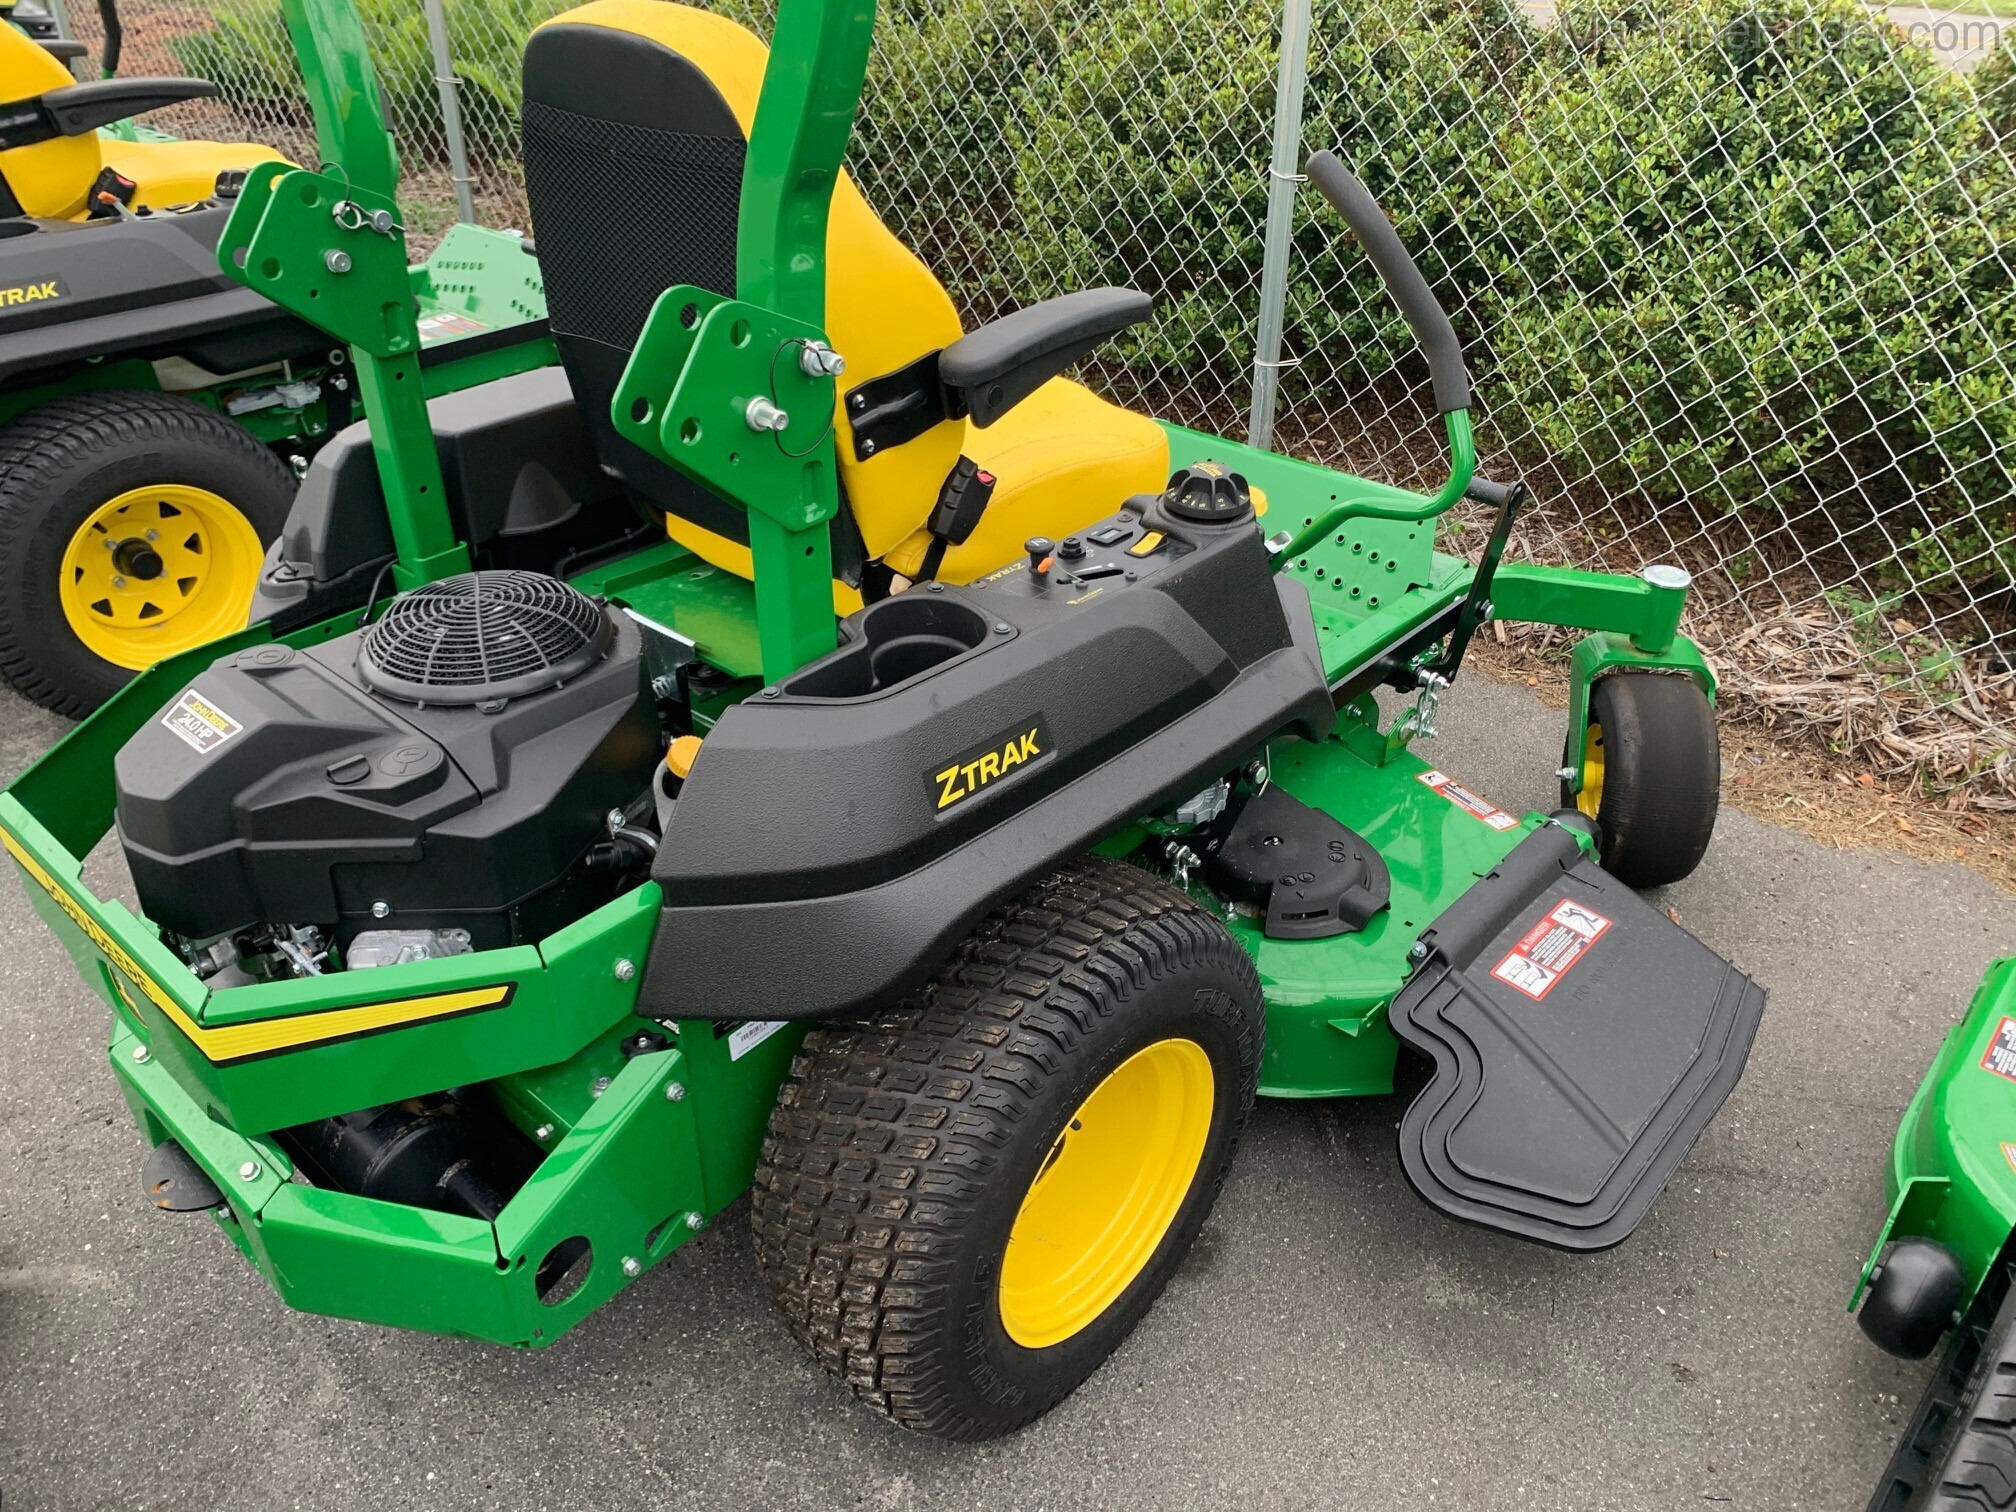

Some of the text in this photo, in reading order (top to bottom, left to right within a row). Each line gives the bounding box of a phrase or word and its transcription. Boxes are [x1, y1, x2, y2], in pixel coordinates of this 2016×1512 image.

[194, 725, 214, 739] HP
[206, 711, 229, 731] DEERE
[935, 727, 1041, 809] ZTRAK
[1524, 920, 1551, 947] DANGER
[1192, 987, 1247, 1030] TURF
